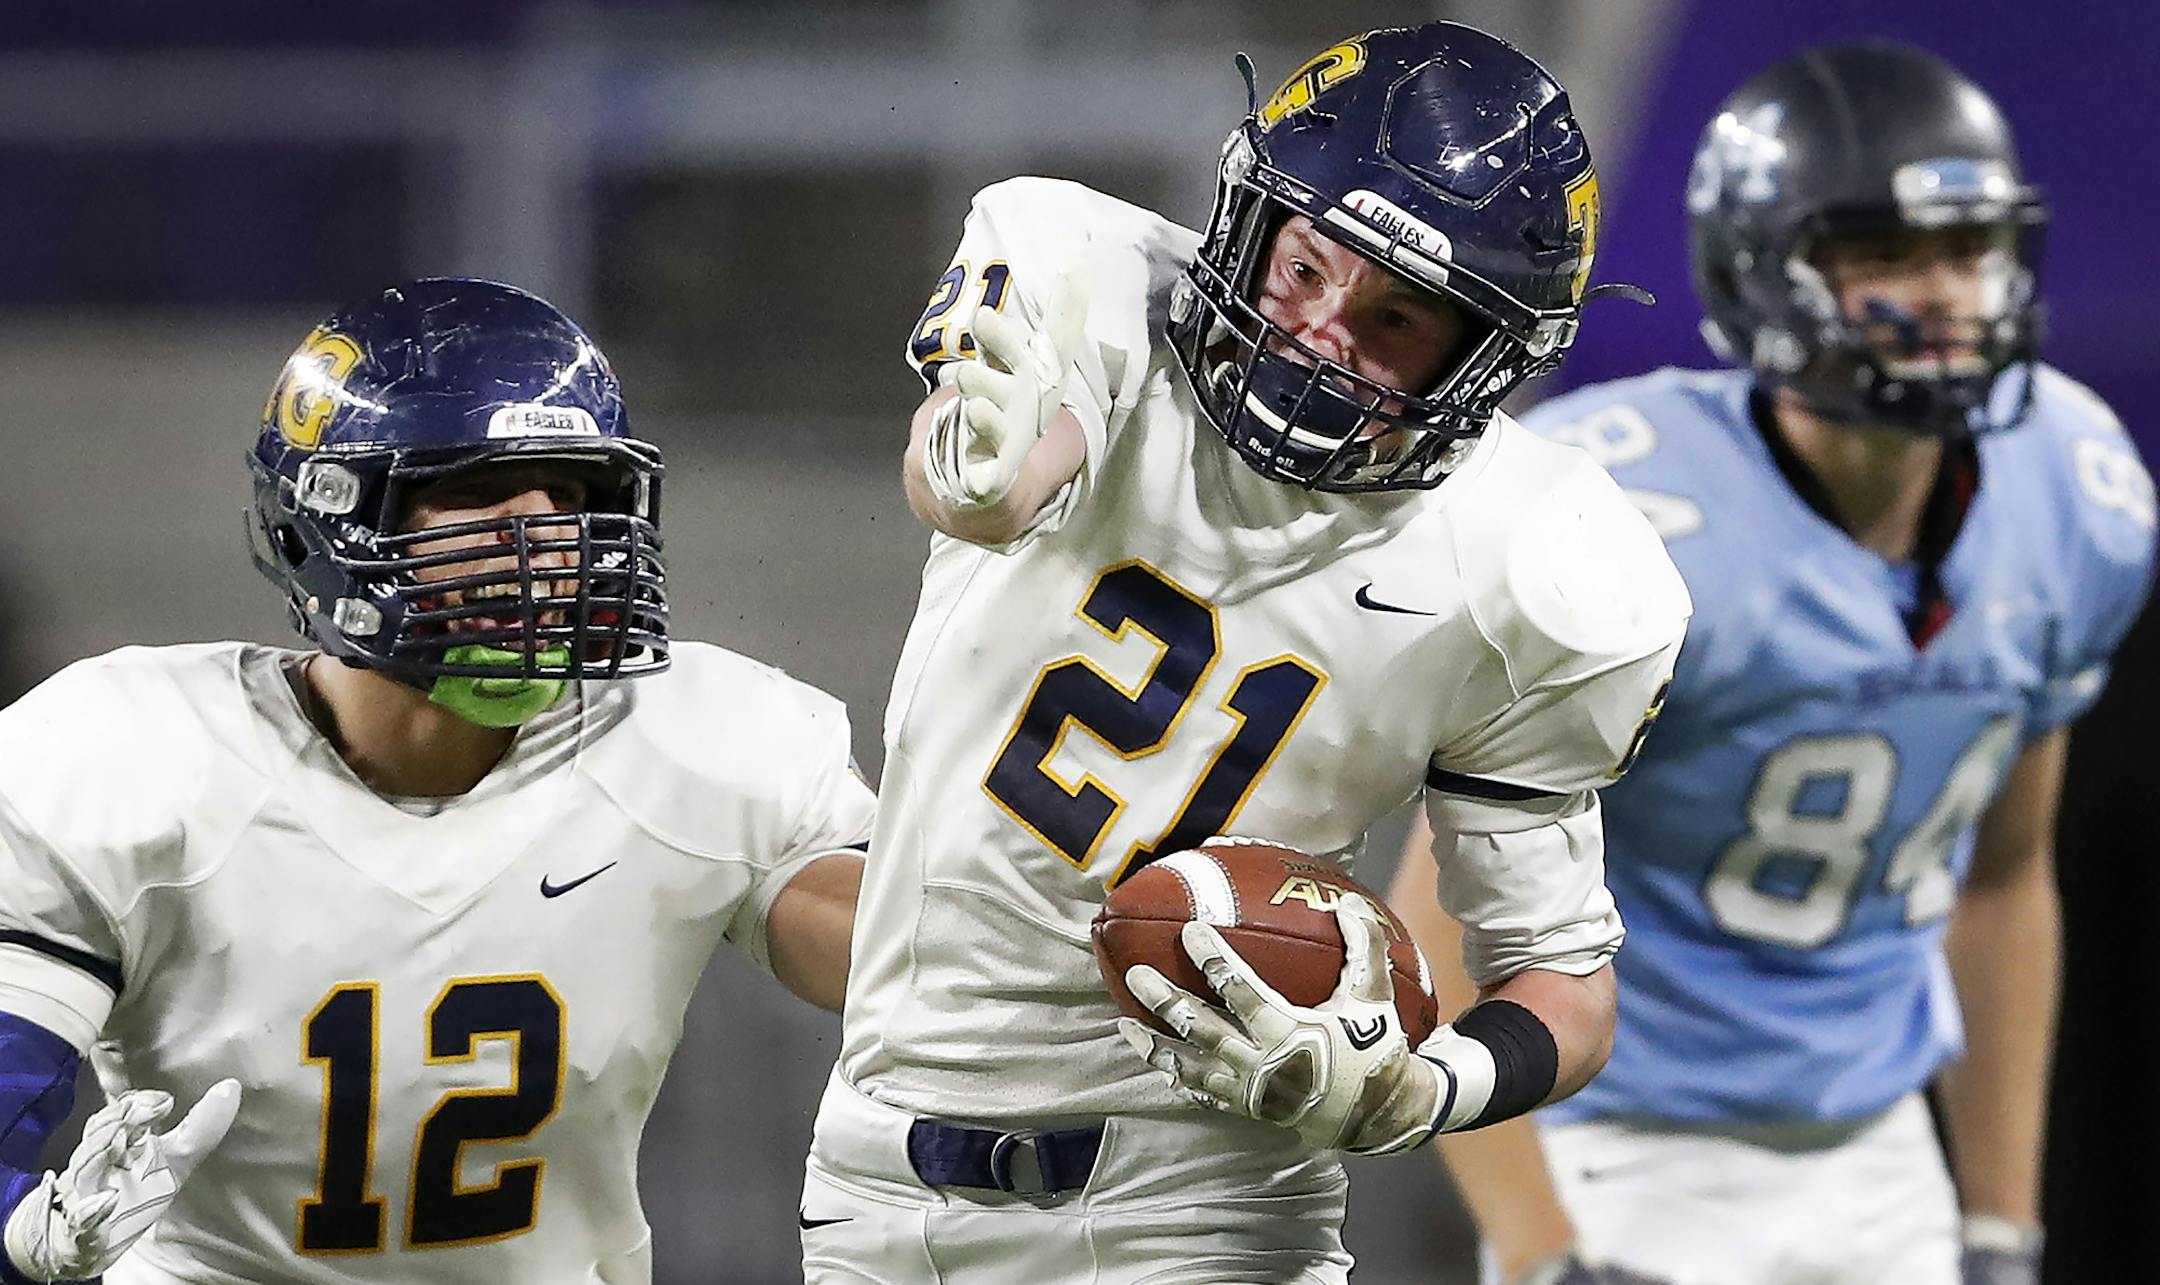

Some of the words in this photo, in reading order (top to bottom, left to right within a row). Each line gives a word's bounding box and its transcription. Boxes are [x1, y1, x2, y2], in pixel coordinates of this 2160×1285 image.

[1369, 206, 1425, 247] EAGLES
[909, 258, 1013, 363] 21
[524, 411, 574, 430] EAGLES
[1248, 436, 1296, 470] Ridell
[980, 555, 1330, 893] 21
[1706, 712, 2024, 947] 84
[296, 971, 568, 1257] 12
